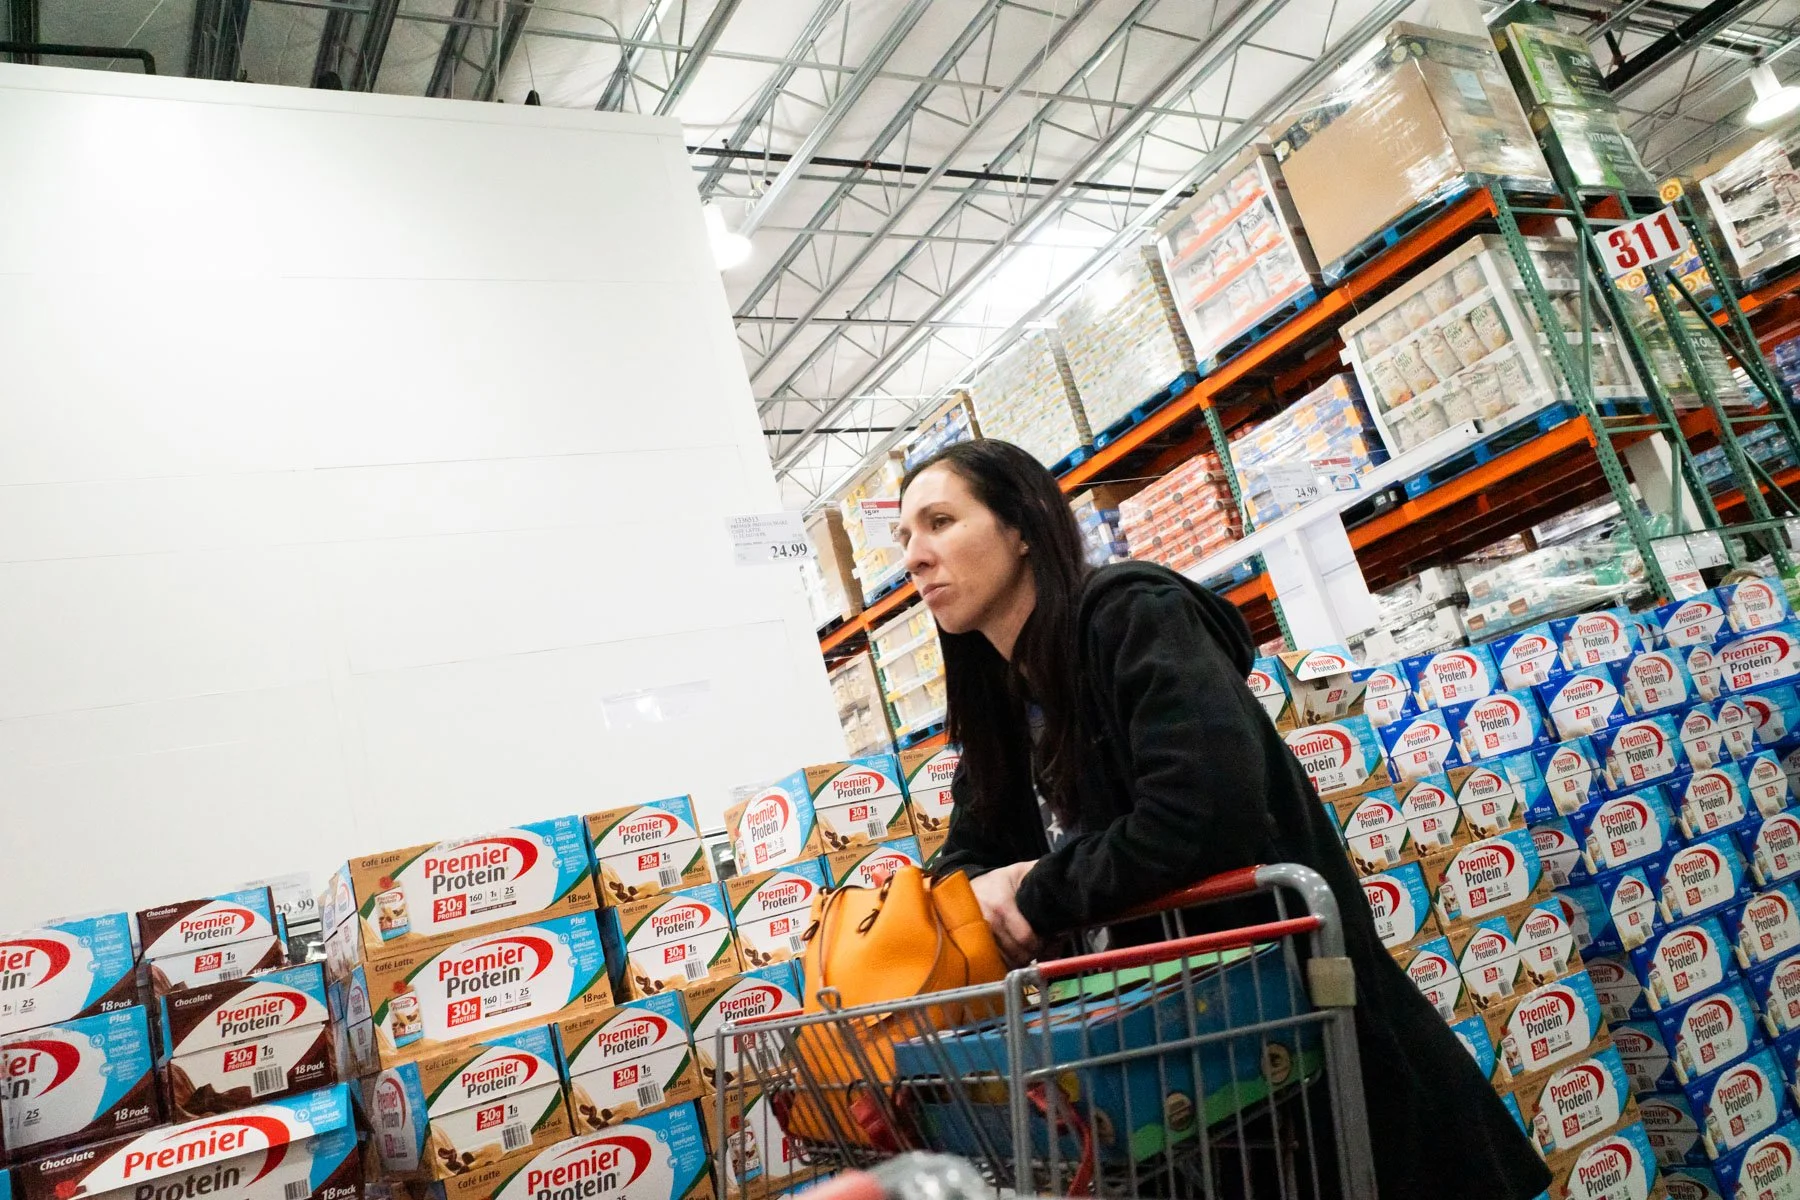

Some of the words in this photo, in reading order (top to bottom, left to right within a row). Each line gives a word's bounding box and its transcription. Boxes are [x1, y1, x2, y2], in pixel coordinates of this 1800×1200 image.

[1608, 213, 1681, 270] 311
[1295, 486, 1318, 498] 24.99
[771, 543, 808, 558] 24.99
[1675, 606, 1703, 620] Premier
[1679, 613, 1703, 625] Protein
[1578, 622, 1609, 636] Premier
[1512, 640, 1539, 655] Premier
[1582, 634, 1610, 648] Protein
[1515, 647, 1539, 659] Protein
[1722, 641, 1770, 663] Premier
[1305, 658, 1335, 668] Premier
[1311, 664, 1338, 673] Protein
[1433, 660, 1466, 674] Premier
[1634, 662, 1663, 678] Premier
[1730, 655, 1772, 674] Protein
[1438, 671, 1467, 684] Protein
[1641, 672, 1666, 688] Protein
[1562, 682, 1594, 697] Premier
[1566, 689, 1593, 703] Protein
[1474, 704, 1509, 722] Premier
[1480, 716, 1510, 732] Protein
[1403, 727, 1431, 741] Premier
[1406, 735, 1431, 747] Protein
[1619, 731, 1652, 749] Premier
[1552, 757, 1574, 769] Premier
[1626, 746, 1654, 764] Protein
[927, 760, 960, 774] Premie
[1302, 756, 1337, 775] rotein
[1557, 763, 1576, 774] Protein
[833, 775, 873, 791] Premier
[932, 771, 955, 782] Prote
[1468, 777, 1494, 789] Premier
[837, 785, 872, 799] Protein
[1472, 784, 1494, 797] Protein
[1692, 779, 1722, 797] Premier
[1409, 792, 1436, 805] Premier
[1413, 800, 1437, 812] Protein
[1699, 795, 1725, 812] Protein
[747, 801, 778, 827] Premier
[1356, 808, 1384, 820] Premier
[1600, 807, 1635, 828] Premier
[554, 820, 571, 829] Plus
[618, 819, 664, 837] Premier
[751, 818, 779, 843] Protein
[1360, 817, 1385, 829] Protein
[1606, 821, 1638, 839] Protein
[622, 829, 662, 845] Protein
[1763, 824, 1791, 842] Premier
[1769, 836, 1794, 853] Protein
[381, 855, 400, 865] Latte
[424, 847, 511, 879] Premier
[640, 854, 657, 866] 30g
[860, 859, 898, 876] Premier
[1458, 851, 1500, 873] Premier
[1674, 855, 1708, 876] Premier
[432, 865, 506, 895] Protein
[1464, 864, 1502, 887] Protein
[1681, 869, 1711, 887] Protein
[469, 893, 483, 903] 160
[505, 886, 515, 895] 25
[567, 894, 578, 904] 18
[577, 892, 592, 901] Pack
[757, 884, 799, 903] Premier
[1471, 889, 1485, 901] 30g
[276, 899, 315, 913] 29.99
[437, 898, 463, 914] 30g
[761, 894, 798, 912] Protein
[146, 907, 178, 918] Chocolate
[437, 909, 462, 921] PROTEIN
[651, 909, 696, 929] Premier
[1748, 902, 1778, 922] Premier
[180, 914, 237, 934] Premier
[570, 917, 587, 926] Plus
[656, 919, 695, 938] Protein
[1525, 918, 1551, 933] Premier
[1755, 916, 1781, 933] Protein
[184, 925, 233, 943] Protein
[1529, 927, 1552, 940] Protein
[667, 948, 683, 959] 30g
[1470, 938, 1497, 953] Premier
[1474, 946, 1498, 961] Protein
[1661, 938, 1696, 959] Premier
[199, 954, 220, 968] 30g
[394, 957, 414, 967] Latte
[438, 946, 526, 982] Premier
[1668, 951, 1699, 972] Protein
[1410, 962, 1438, 977] Premier
[446, 966, 521, 999] Protein
[1414, 971, 1439, 985] Protein
[520, 987, 530, 996] 25
[583, 994, 593, 1004] 18
[593, 991, 608, 1001] Pack
[22, 998, 34, 1008] 25
[100, 1000, 114, 1012] 18
[114, 999, 133, 1009] Pack
[175, 992, 213, 1008] Chocolate
[484, 996, 497, 1006] 160
[719, 991, 767, 1015] Premier
[216, 998, 286, 1026] Premier
[452, 1002, 477, 1018] 30g
[1519, 998, 1561, 1025] Premier
[109, 1013, 132, 1024] Plus
[221, 1013, 281, 1038] Protein
[451, 1013, 477, 1025] PROTEIN
[1526, 1013, 1563, 1039] Protein
[1688, 1008, 1722, 1030] Premier
[598, 1022, 651, 1047] Premier
[1694, 1021, 1724, 1043] Protein
[603, 1036, 648, 1058] Protein
[228, 1049, 253, 1065] 30g
[295, 1064, 306, 1074] 18
[306, 1061, 325, 1071] Pack
[461, 1060, 520, 1088] Premier
[617, 1069, 636, 1081] 30g
[467, 1075, 517, 1099] Protein
[677, 1078, 691, 1087] Pack
[1550, 1073, 1591, 1099] Premier
[1717, 1078, 1751, 1103] Premier
[1557, 1088, 1593, 1116] Protein
[1724, 1094, 1754, 1116] Protein
[26, 1108, 40, 1120] 25
[114, 1108, 129, 1122] 18
[128, 1105, 149, 1118] Pack
[481, 1108, 501, 1123] 30g
[669, 1108, 686, 1120] Plus
[123, 1127, 249, 1178] Premier
[40, 1151, 95, 1171] Chocolate
[1578, 1153, 1620, 1181] Premier
[1746, 1152, 1780, 1176] Premier
[458, 1176, 477, 1189] Café
[479, 1169, 500, 1182] Latte
[527, 1148, 621, 1196] Premier
[1753, 1167, 1783, 1191] Protein
[134, 1164, 241, 1200] Protein
[1586, 1169, 1621, 1198] Protein
[321, 1188, 336, 1200] 18
[336, 1184, 356, 1196] Pack
